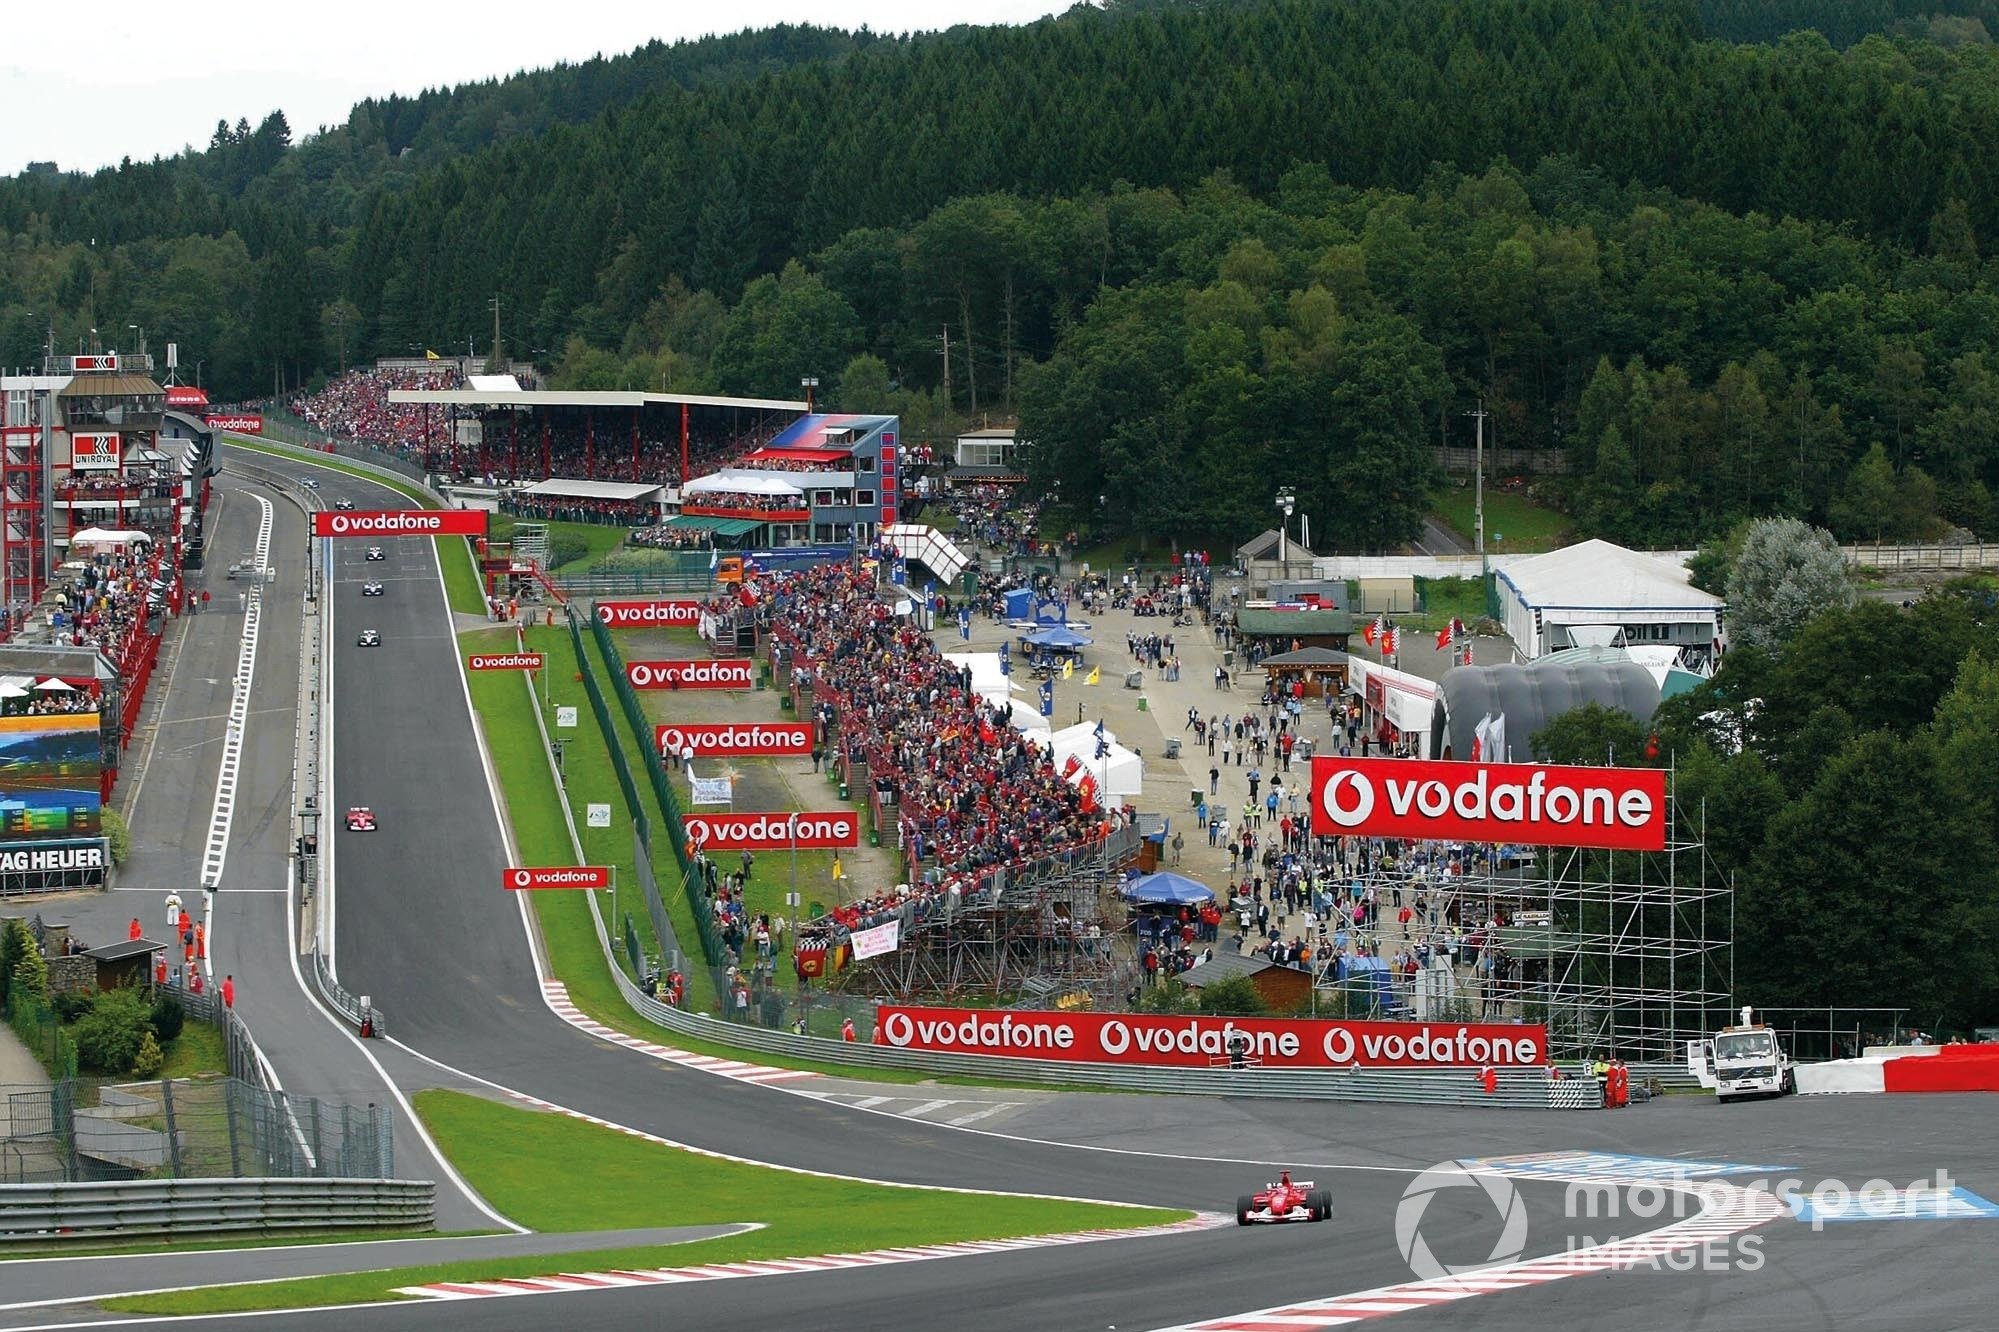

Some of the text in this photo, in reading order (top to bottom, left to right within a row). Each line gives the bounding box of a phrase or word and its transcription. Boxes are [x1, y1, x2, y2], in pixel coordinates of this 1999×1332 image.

[75, 454, 117, 464] UNIROYAL
[352, 514, 441, 529] vodafone
[617, 603, 701, 621] vodafon
[484, 656, 540, 666] vodafone
[687, 727, 806, 748] vodafone
[1385, 769, 1653, 826] vodafone
[714, 816, 850, 841] vodafone
[0, 848, 102, 871] AG HEUER
[535, 872, 598, 883] vodafone
[917, 1014, 1074, 1047] vodafone
[1133, 1020, 1300, 1057] vodafone
[1362, 1027, 1538, 1064] vodafone
